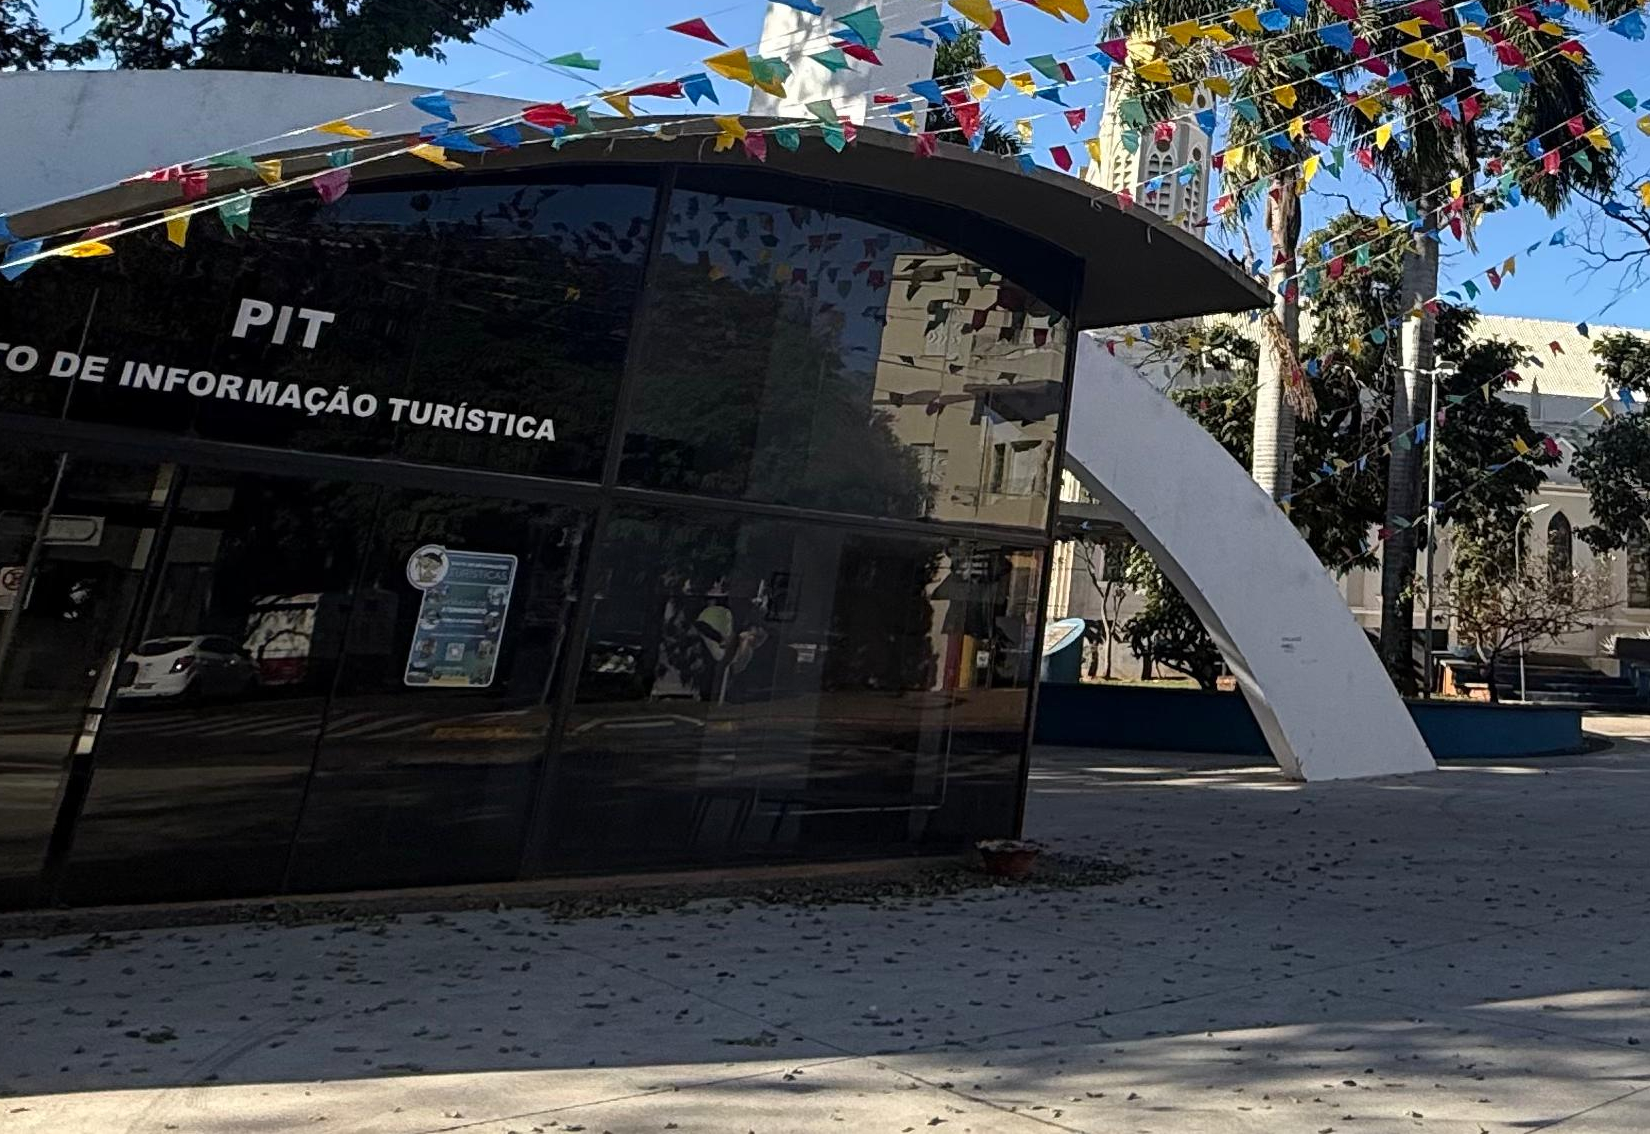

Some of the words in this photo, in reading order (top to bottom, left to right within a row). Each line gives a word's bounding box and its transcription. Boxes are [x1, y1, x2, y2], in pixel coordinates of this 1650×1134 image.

[231, 298, 336, 349] PIT
[49, 350, 109, 383] DE
[118, 360, 378, 417] INFORMAÇÃO
[388, 397, 556, 442] TURÍSTICA
